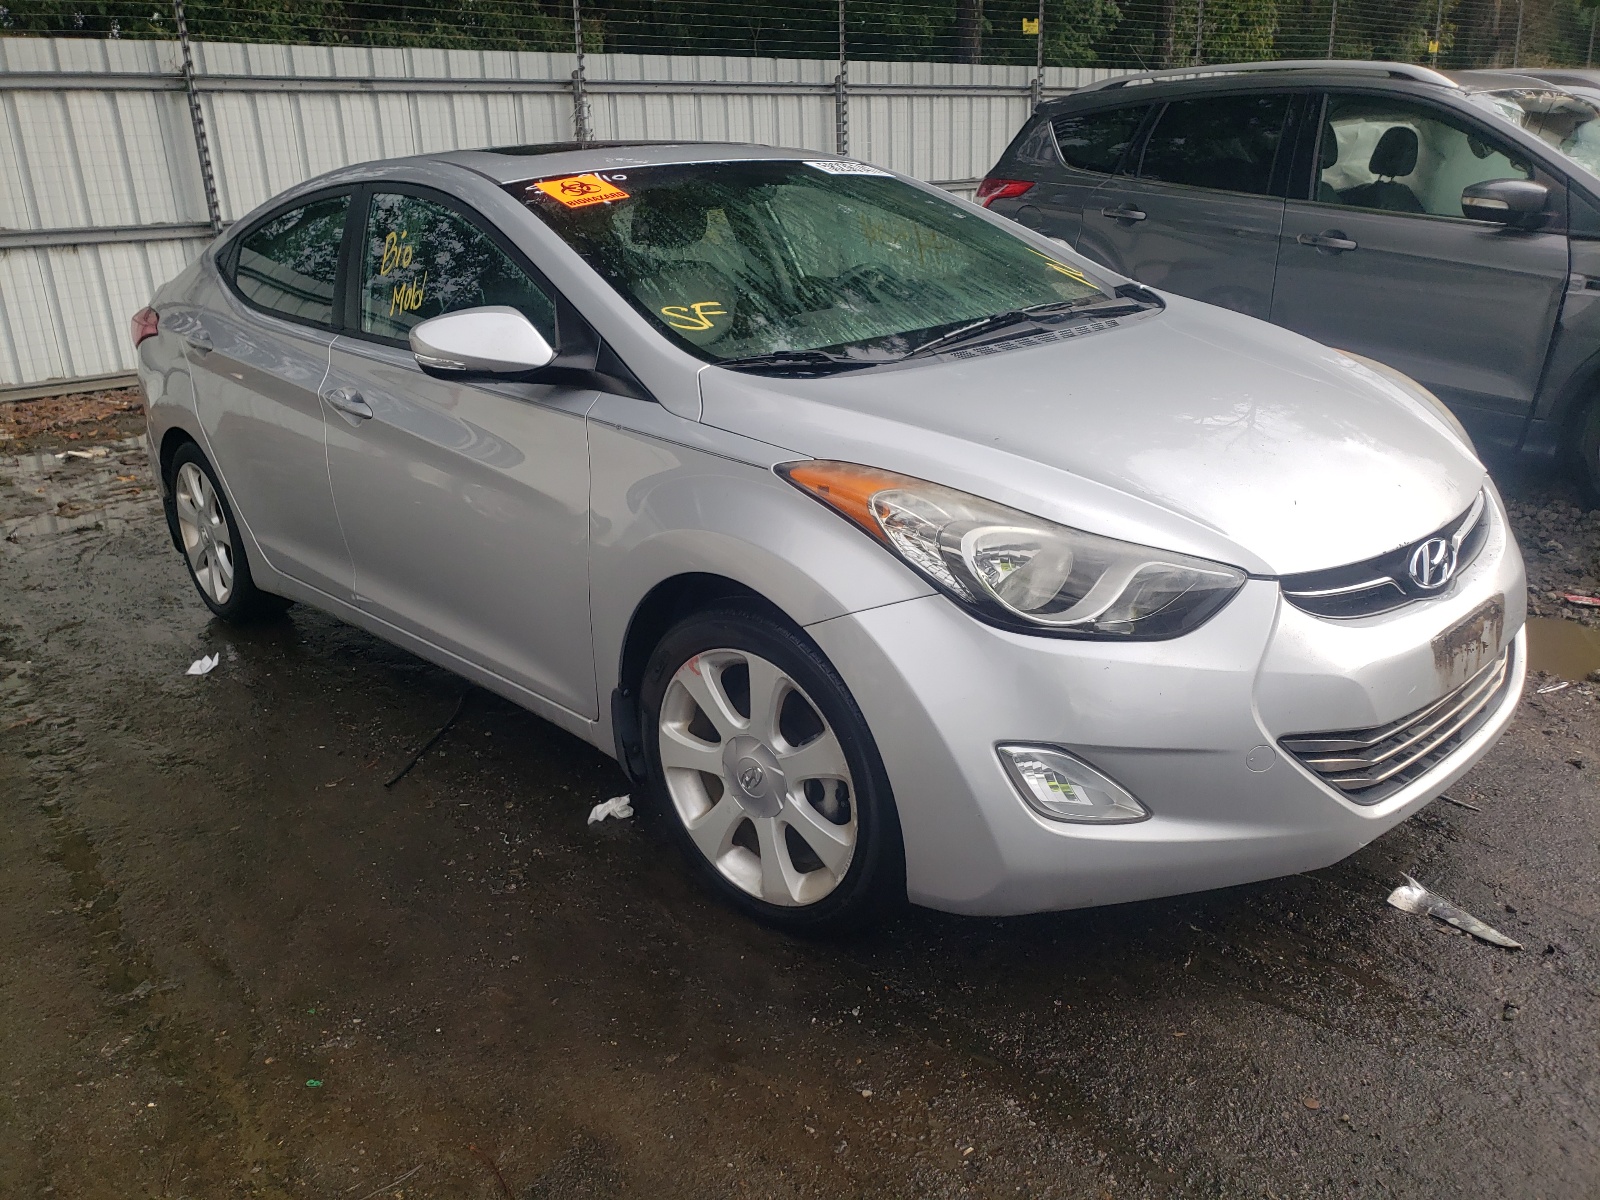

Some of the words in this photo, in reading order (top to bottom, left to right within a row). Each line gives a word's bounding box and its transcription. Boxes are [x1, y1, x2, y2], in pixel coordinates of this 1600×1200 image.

[566, 191, 626, 207] BIOHAZARD
[381, 229, 412, 276] Bio
[661, 301, 727, 330] SF
